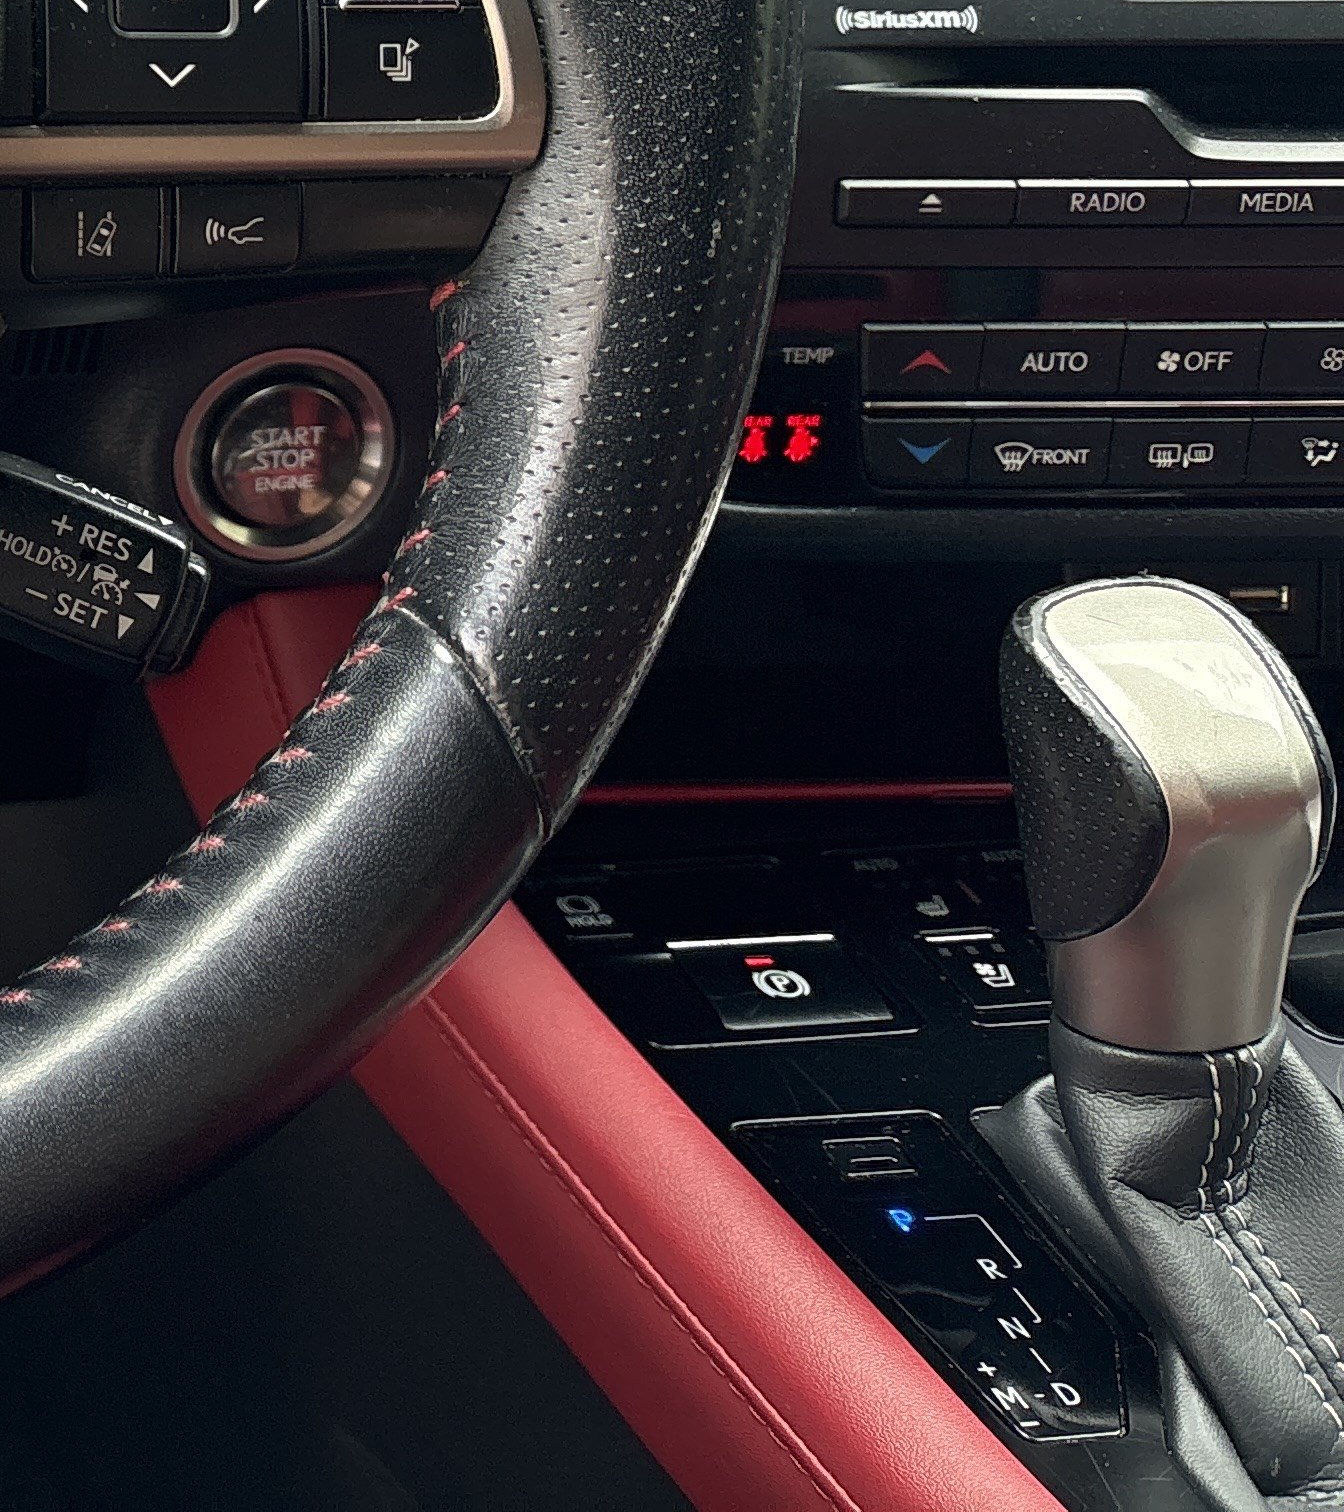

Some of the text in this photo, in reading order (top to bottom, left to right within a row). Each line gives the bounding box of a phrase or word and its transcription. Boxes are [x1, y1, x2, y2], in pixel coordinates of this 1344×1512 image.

[1069, 192, 1146, 213] RADIO
[1239, 192, 1315, 214] MEDIA
[781, 347, 835, 365] TEMP
[1020, 352, 1089, 373] AUTO
[1184, 351, 1234, 372] OFF
[250, 426, 327, 448] START
[254, 448, 316, 471] STOP
[1032, 447, 1091, 466] FRONT
[254, 474, 316, 493] ENGINE
[55, 473, 158, 522] CANCEL
[78, 523, 133, 562] RES
[52, 592, 109, 630] SET
[975, 1258, 1008, 1280] R
[997, 1315, 1032, 1339] N
[991, 1382, 1082, 1411] M D
